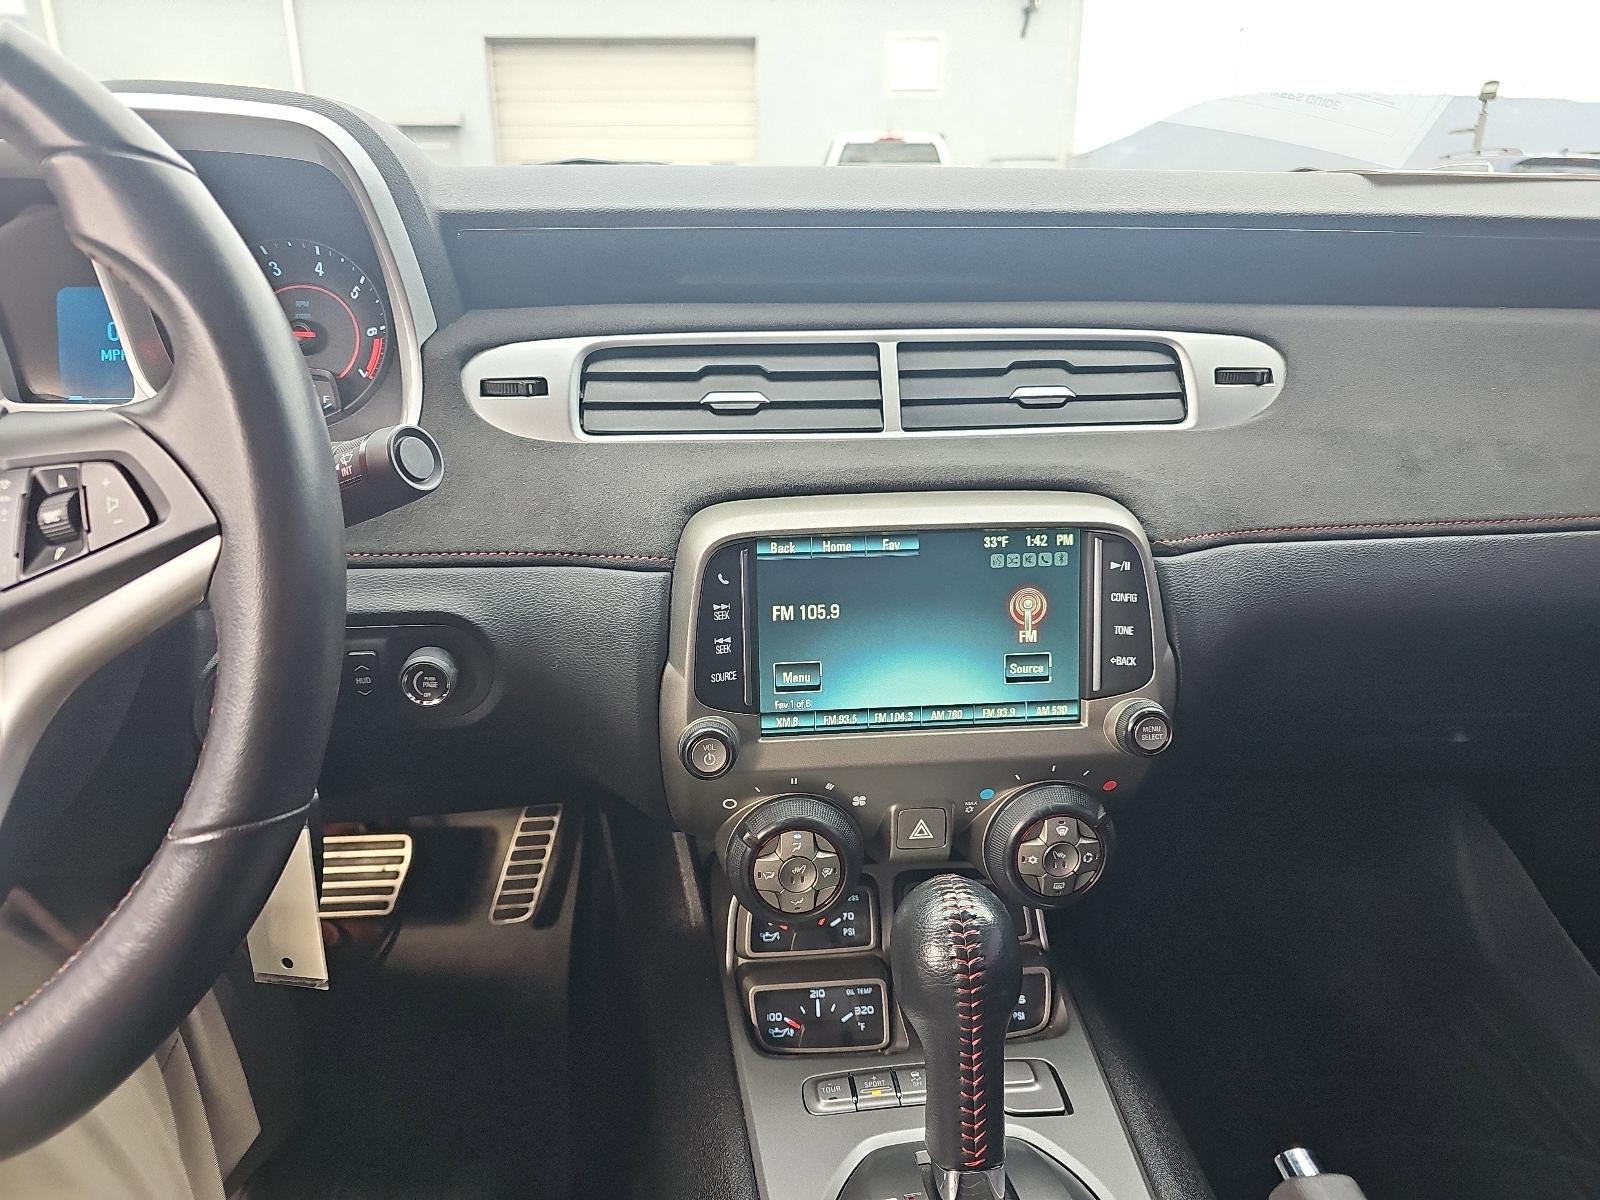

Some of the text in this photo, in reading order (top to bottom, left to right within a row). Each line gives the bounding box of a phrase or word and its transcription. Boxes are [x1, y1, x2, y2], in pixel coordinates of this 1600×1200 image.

[268, 261, 282, 277] 3
[314, 261, 325, 277] 4
[350, 284, 361, 299] 5
[366, 326, 378, 337] 6
[358, 368, 369, 378] 7
[340, 464, 353, 478] INT
[882, 538, 901, 551] Fav
[1025, 533, 1074, 547] 1:42 PM
[770, 541, 796, 554] Back
[822, 540, 852, 553] Home
[1110, 592, 1138, 603] CONFIG
[713, 610, 731, 621] SEEK
[772, 603, 840, 621] FM 105.9
[1113, 625, 1135, 636] TONE
[1018, 630, 1038, 643] FM
[715, 643, 732, 654] SEEK
[1115, 656, 1137, 666] BACK
[1009, 663, 1044, 674] Source
[710, 671, 737, 682] SOURCE
[783, 672, 811, 683] Menu
[774, 700, 788, 710] Fav
[797, 699, 804, 709] of
[931, 711, 945, 720] AM
[982, 707, 1016, 718] FM 93.9
[1036, 707, 1051, 716] AM
[775, 716, 799, 728] XM 8
[823, 715, 837, 726] FM
[875, 713, 888, 723] FM
[1141, 733, 1163, 741] SELECT
[842, 911, 855, 921] 70
[842, 927, 856, 937] PSI
[809, 988, 826, 999] 210
[845, 987, 873, 996] OIL TEMP
[854, 1005, 875, 1016] 320
[1012, 1011, 1026, 1021] PSI
[766, 1012, 783, 1022] 100
[821, 1085, 841, 1094] TOUR
[863, 1080, 886, 1088] SPORT
